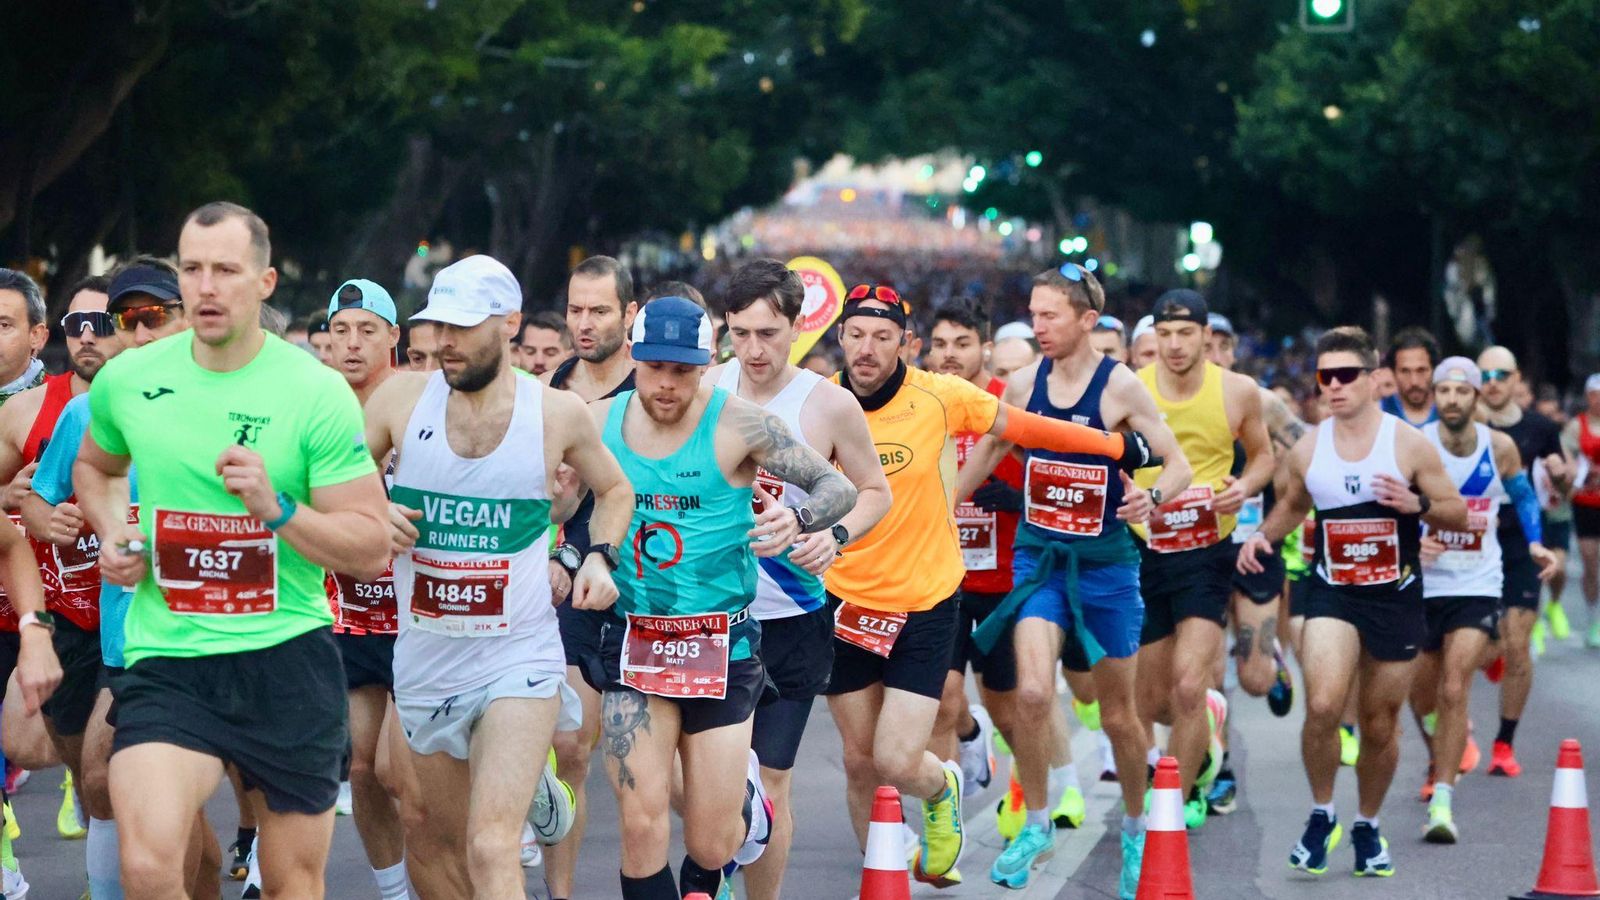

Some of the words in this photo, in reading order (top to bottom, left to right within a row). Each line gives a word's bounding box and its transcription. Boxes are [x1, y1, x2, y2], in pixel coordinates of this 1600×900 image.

[676, 470, 701, 478] HUUB
[1048, 466, 1101, 480] GENERALI
[635, 493, 700, 511] PRESTON
[1046, 485, 1084, 503] 2016
[423, 495, 511, 528] VEGAN
[1163, 508, 1199, 525] 3088
[428, 531, 499, 550] RUNNERS
[959, 528, 979, 540] 27
[185, 547, 243, 570] 7637
[1343, 543, 1379, 557] 3086
[355, 583, 394, 598] 5294
[426, 580, 487, 603] 14845
[474, 623, 492, 631] 21K
[655, 617, 721, 632] GENERALI
[858, 615, 898, 633] 5716
[652, 640, 700, 658] 6503
[693, 677, 713, 685] 42K
